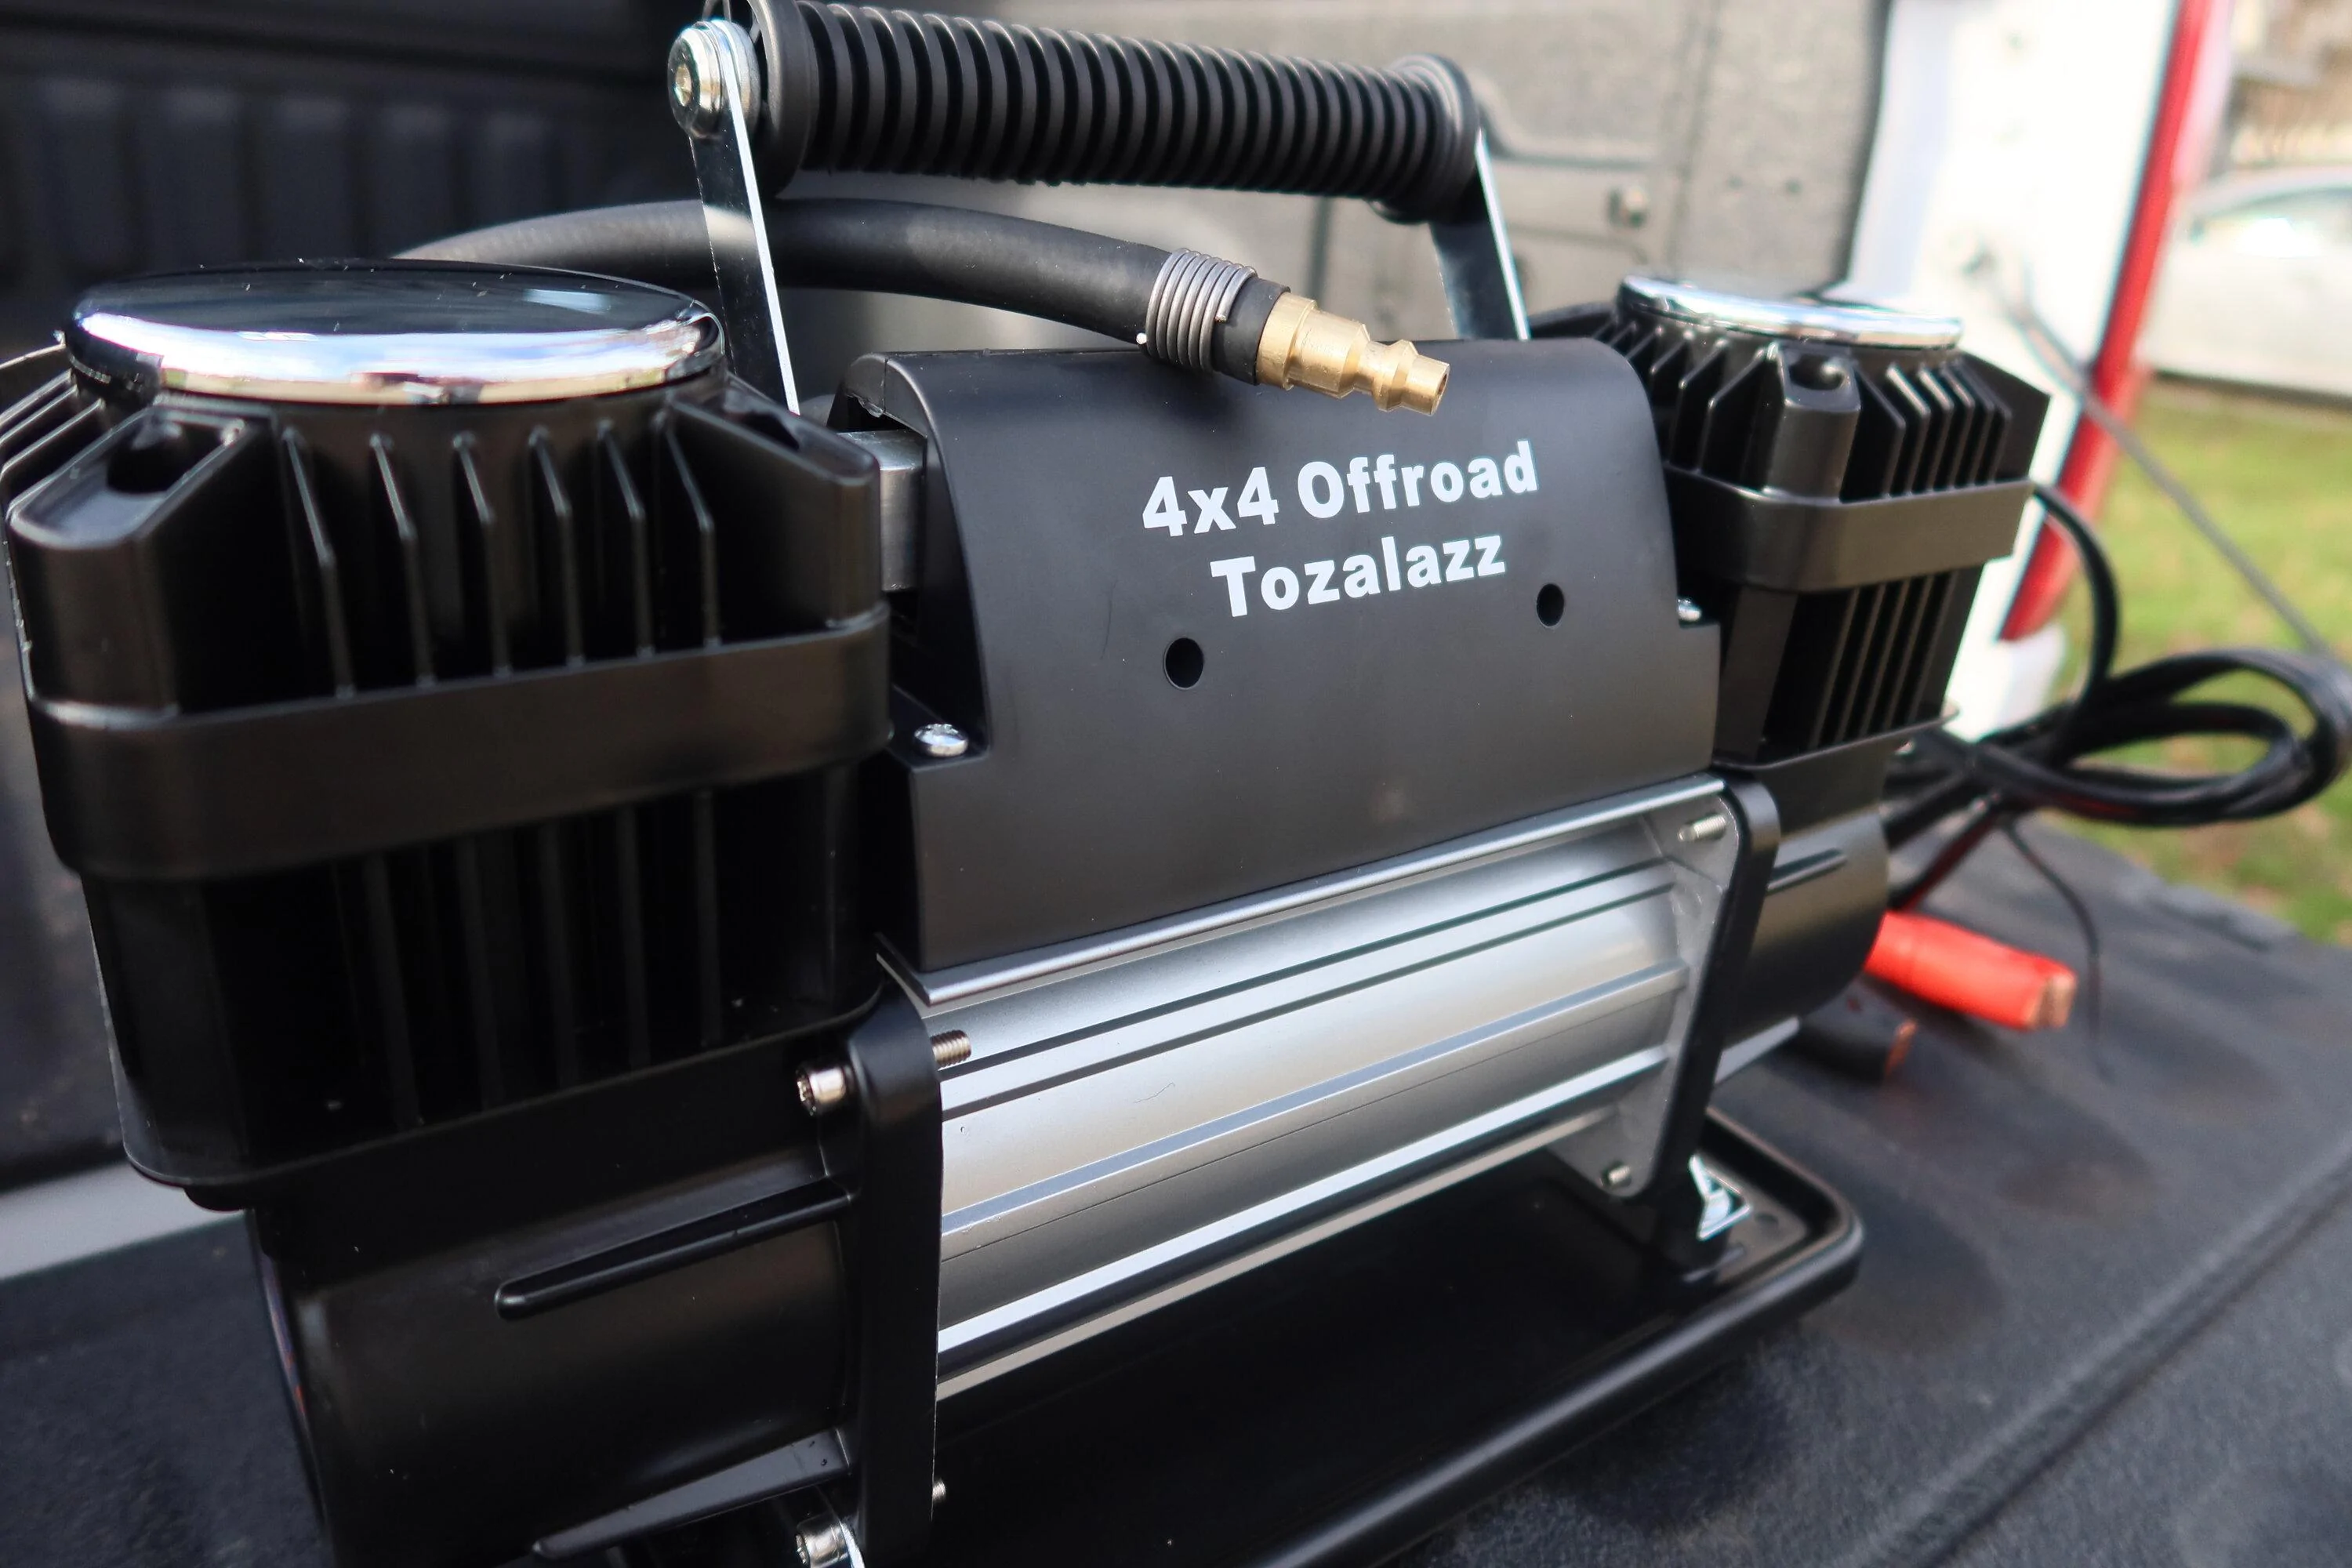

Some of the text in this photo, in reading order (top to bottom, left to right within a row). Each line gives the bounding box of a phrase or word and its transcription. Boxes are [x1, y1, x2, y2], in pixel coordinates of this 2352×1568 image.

[1142, 440, 1537, 537] 4x4 Offroad
[1210, 535, 1505, 617] Tozalazz
